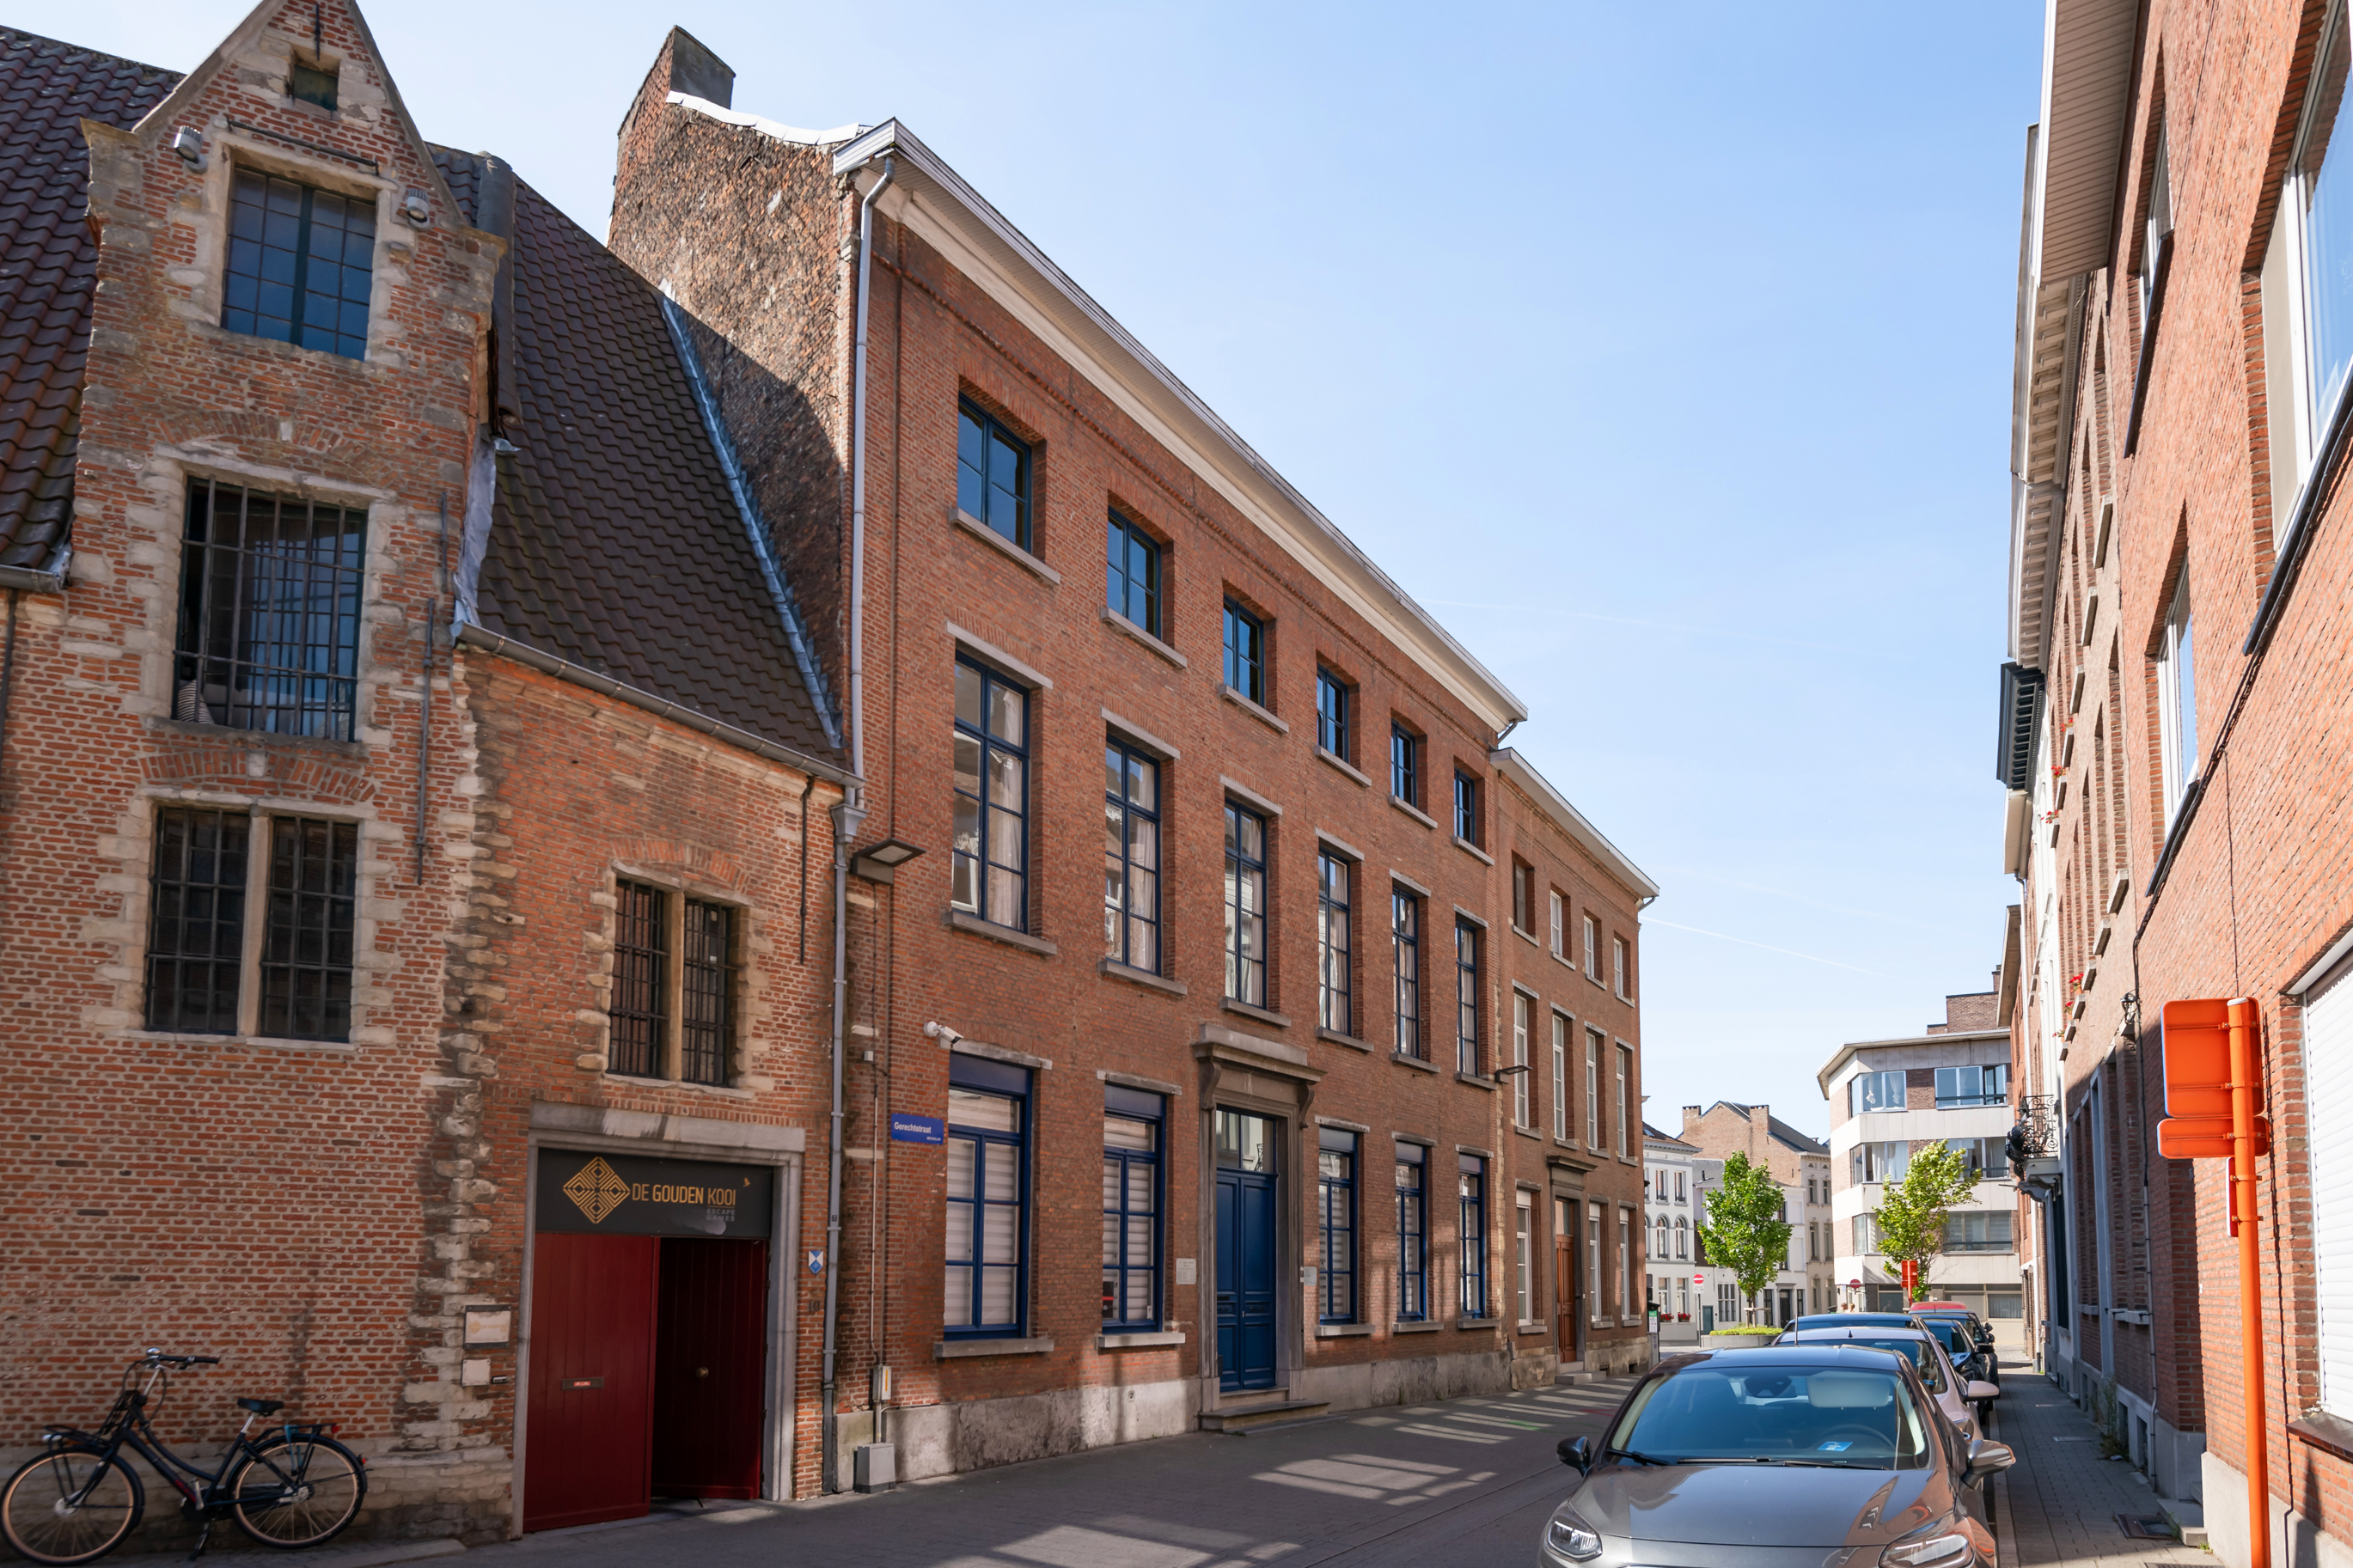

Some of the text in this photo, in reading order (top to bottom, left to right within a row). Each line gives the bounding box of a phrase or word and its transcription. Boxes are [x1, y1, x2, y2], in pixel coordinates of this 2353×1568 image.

[894, 1121, 932, 1133] Gerechtstraat
[632, 1183, 736, 1206] DE GOUDEN KOOI
